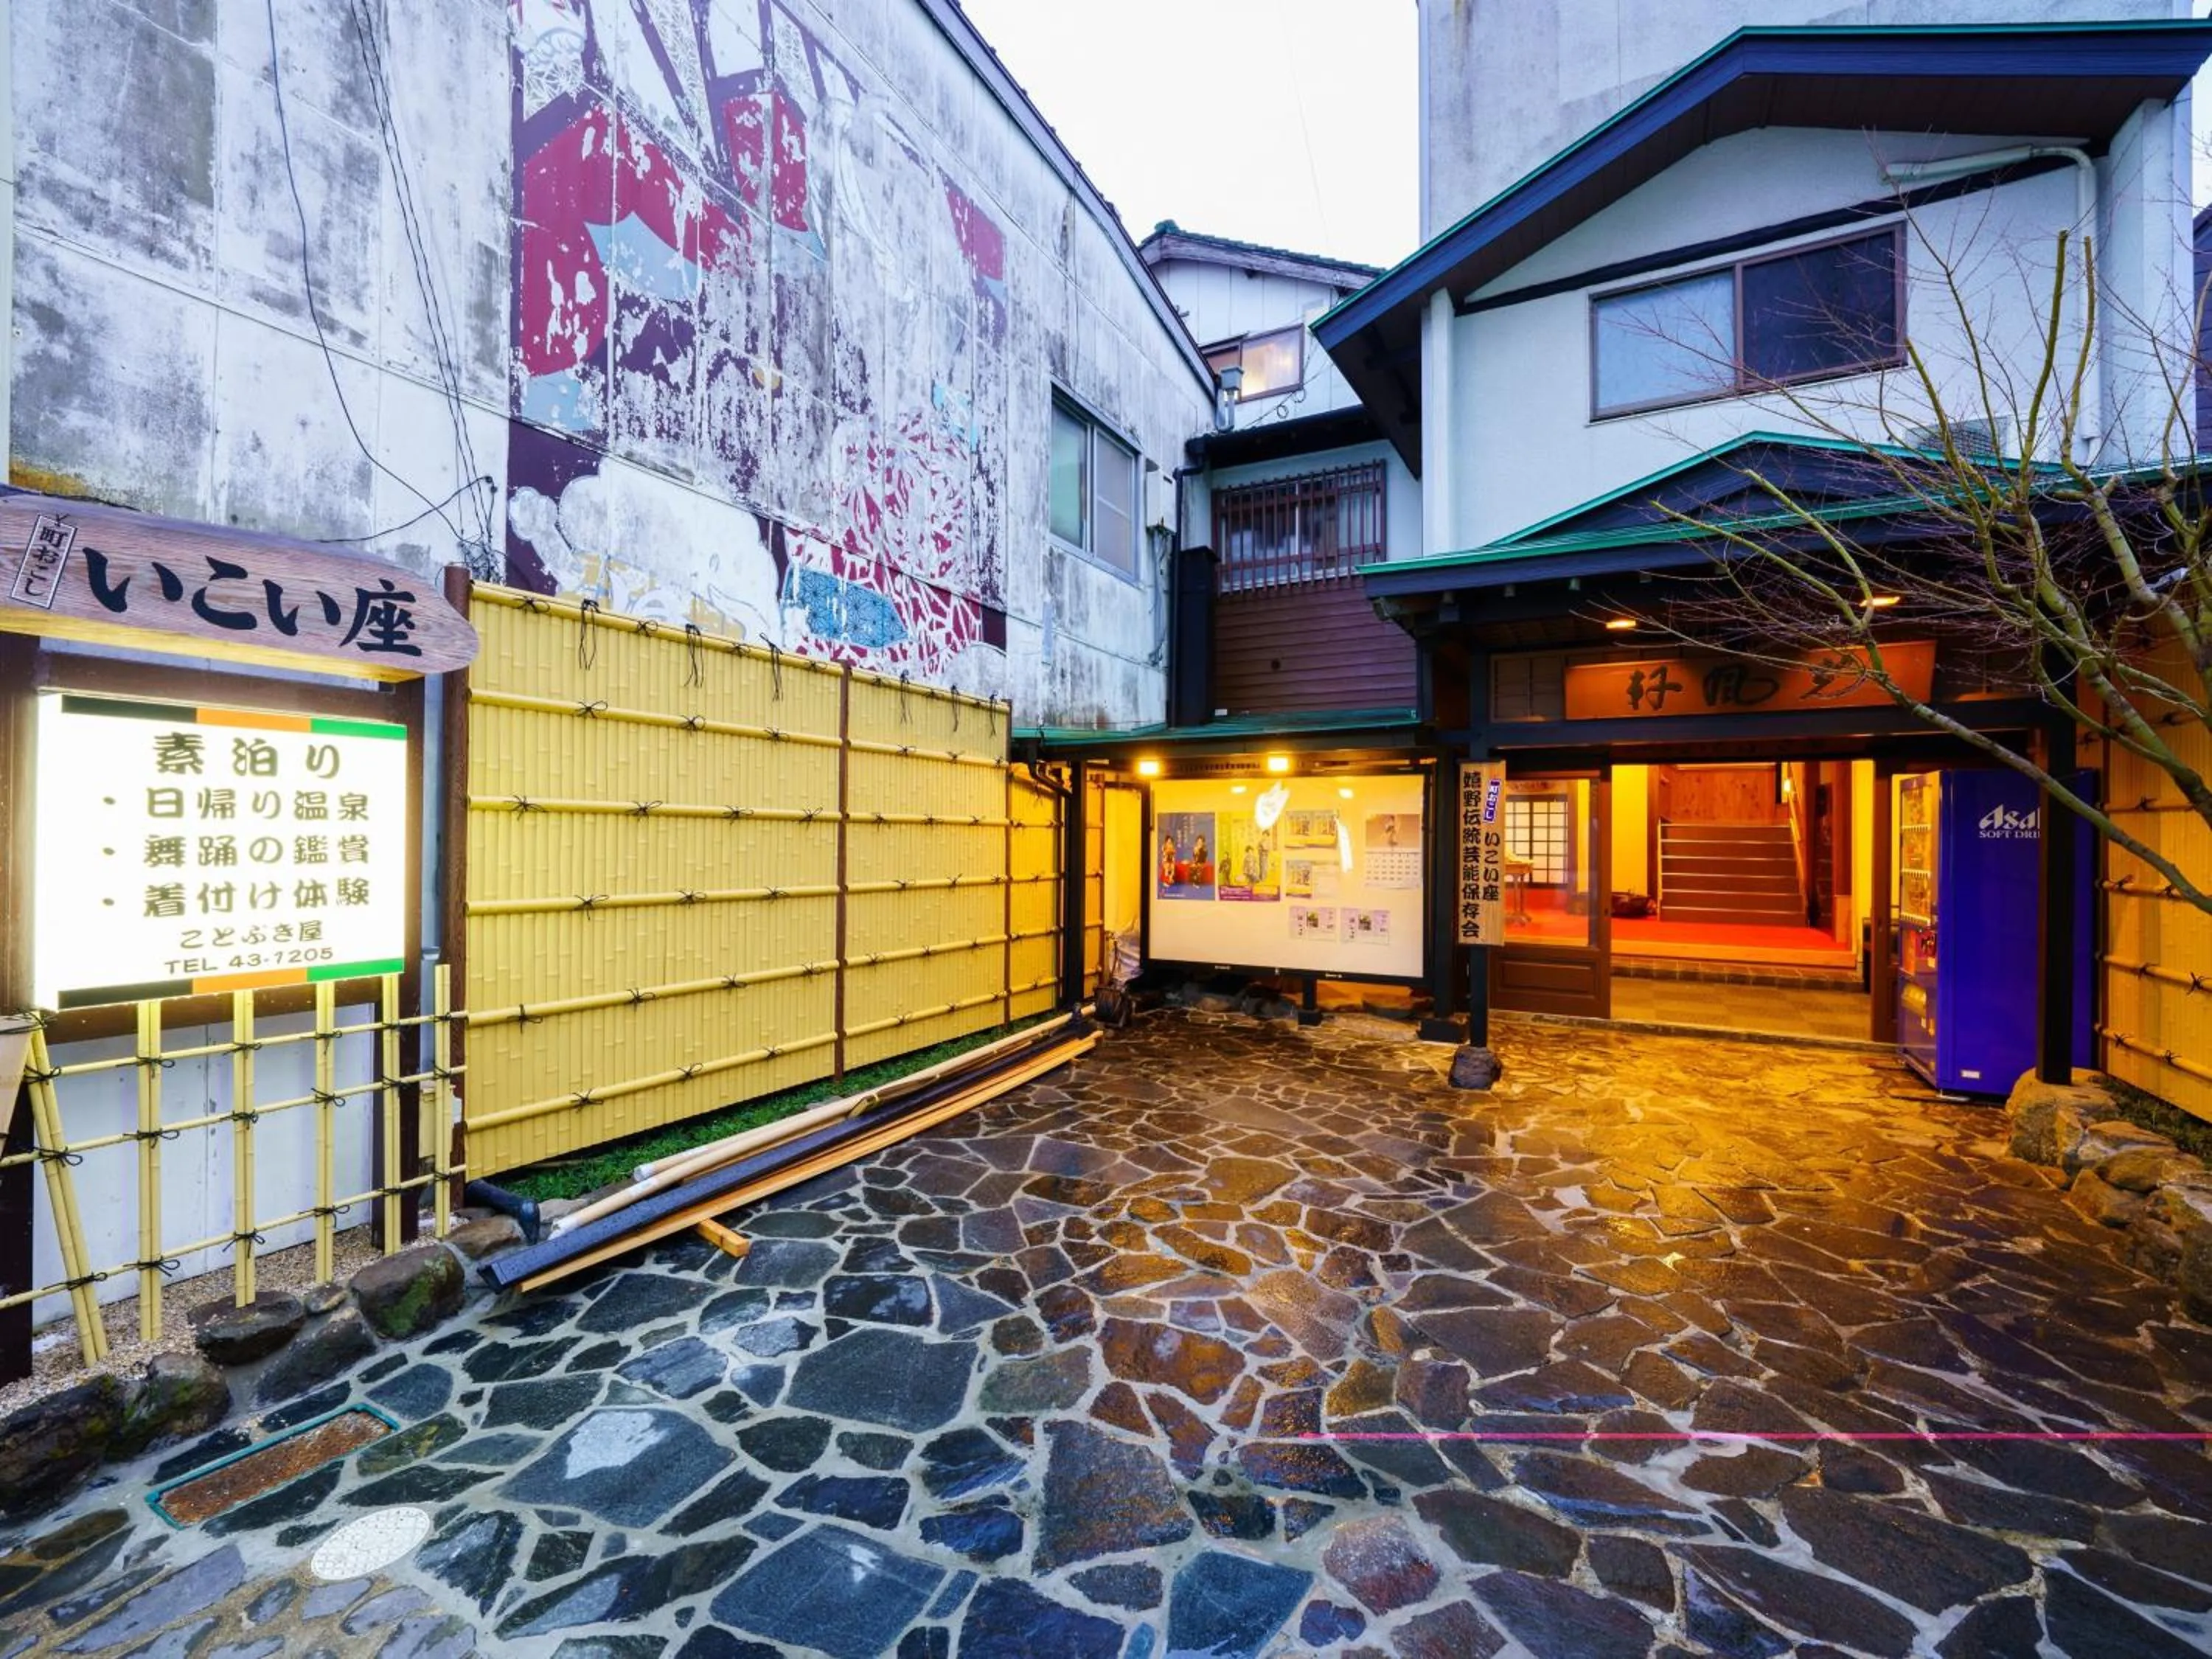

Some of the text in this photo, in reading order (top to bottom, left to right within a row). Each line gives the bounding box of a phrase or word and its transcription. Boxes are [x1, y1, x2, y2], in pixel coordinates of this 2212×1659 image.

[24, 526, 69, 596] 町おこし
[83, 547, 422, 656] いこい座
[153, 732, 340, 778] 素泊り
[146, 787, 369, 821] 日帰り温泉
[144, 835, 369, 867] 舞踊の鑑賞
[1979, 830, 2040, 838] SOFT DRI
[1462, 771, 1481, 938] 嬉野伝統芸能保存会
[1484, 832, 1500, 901] いこい座
[144, 877, 369, 917] 着付け体験
[180, 920, 323, 949] ことぶき屋
[164, 959, 218, 974] TEL
